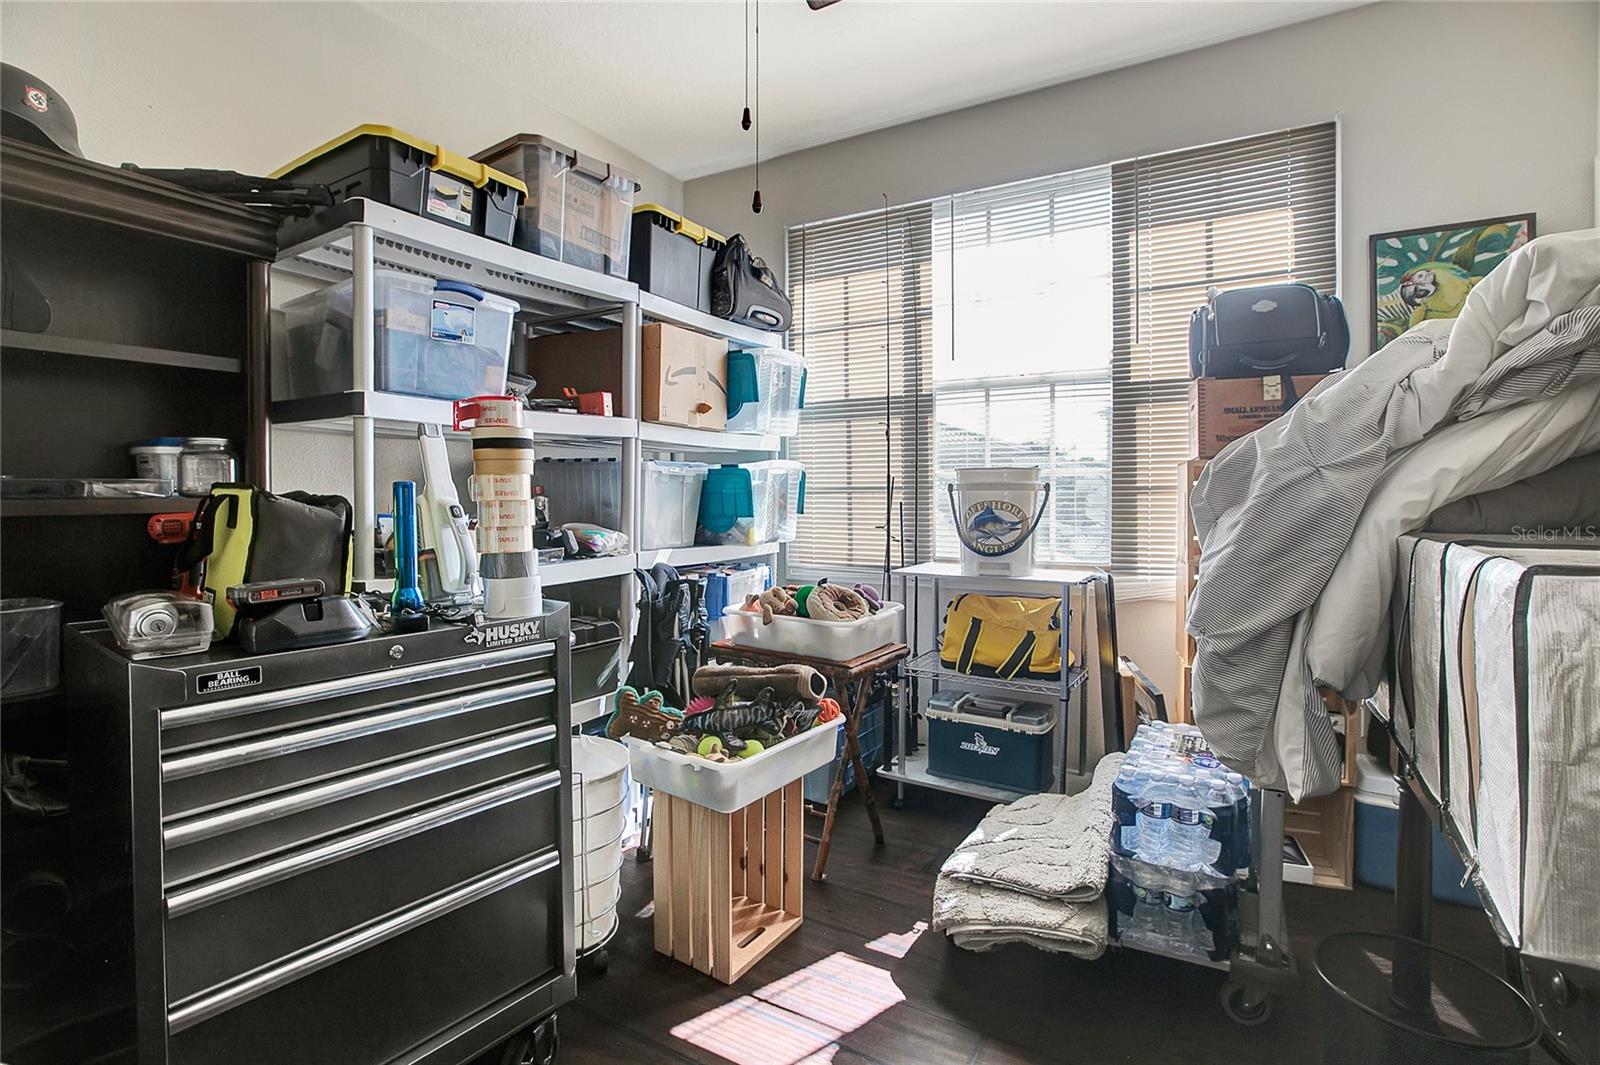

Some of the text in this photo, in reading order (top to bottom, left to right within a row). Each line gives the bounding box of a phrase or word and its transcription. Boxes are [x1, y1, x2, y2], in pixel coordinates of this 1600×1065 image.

[965, 501, 1025, 520] OFFSHORE
[485, 620, 541, 642] HUSKY
[485, 633, 541, 648] LIMITED EDITION
[208, 674, 250, 688] BEARING
[216, 670, 241, 680] BALL
